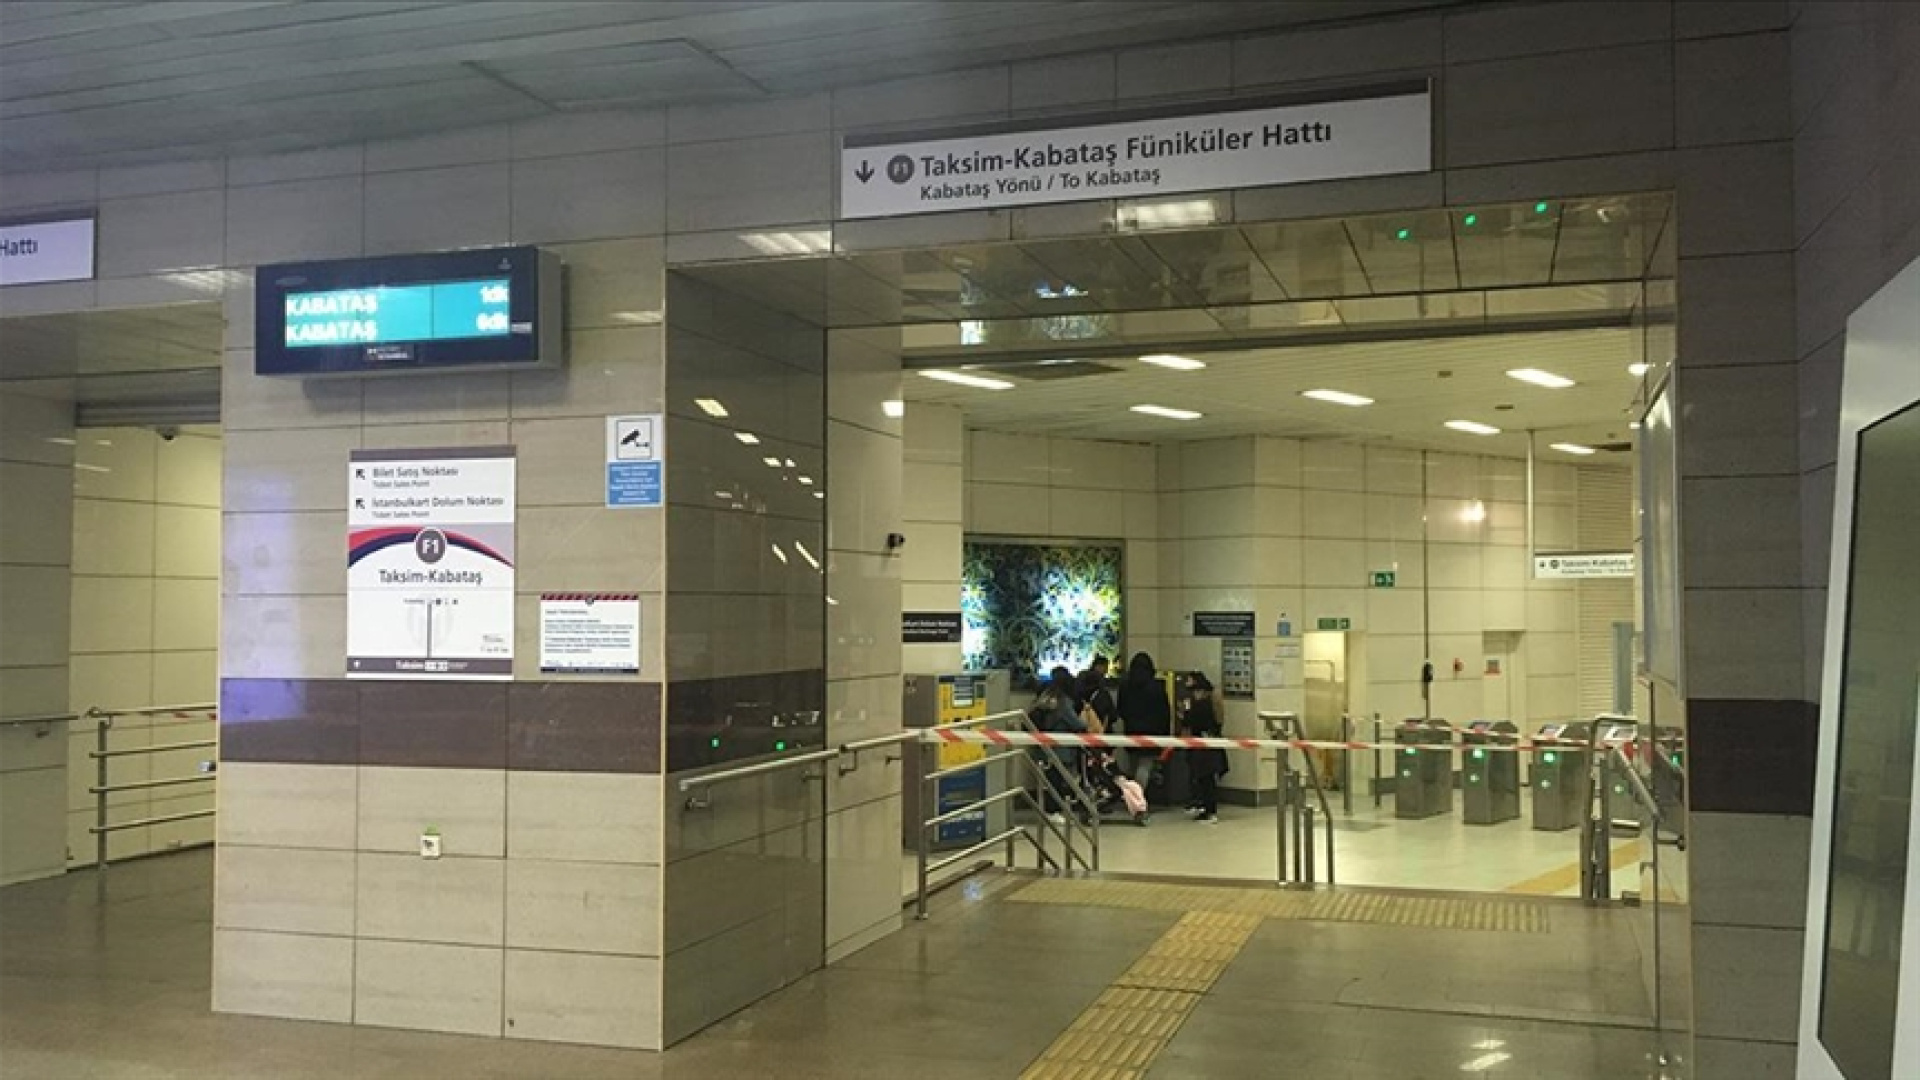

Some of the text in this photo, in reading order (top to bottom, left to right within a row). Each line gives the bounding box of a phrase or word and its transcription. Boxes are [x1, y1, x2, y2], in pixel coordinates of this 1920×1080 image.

[920, 143, 1118, 177] Taksim-Kabataş
[1127, 128, 1253, 160] Füniküler
[1263, 122, 1331, 148] Hattı
[920, 180, 990, 200] Kabataş
[996, 174, 1042, 194] Yönü
[1059, 172, 1080, 188] To
[1086, 167, 1161, 187] Kabataş
[422, 539, 439, 554] F1
[378, 568, 484, 585] Taksim-Kabataş
